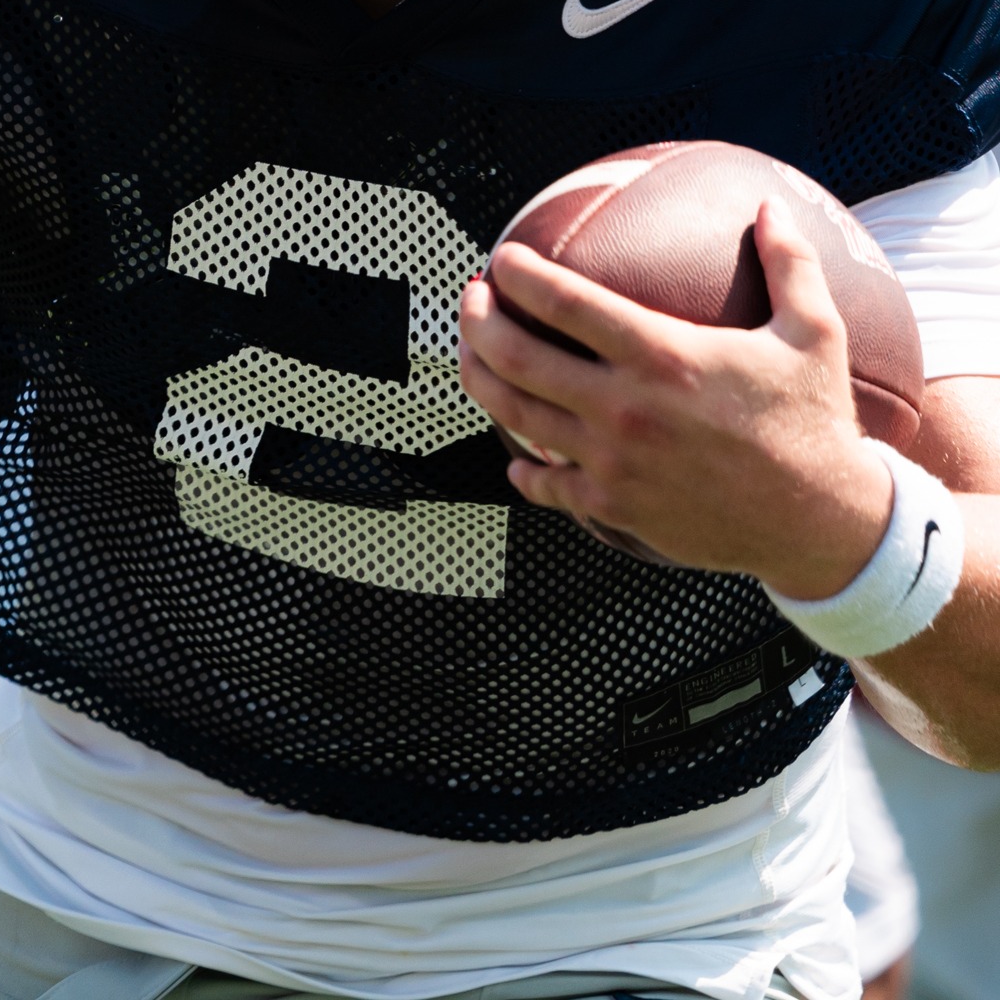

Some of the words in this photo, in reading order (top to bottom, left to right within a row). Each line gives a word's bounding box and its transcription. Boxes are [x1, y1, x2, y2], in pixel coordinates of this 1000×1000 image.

[153, 160, 510, 600] 2
[781, 645, 796, 668] L
[631, 716, 678, 737] TEAM
